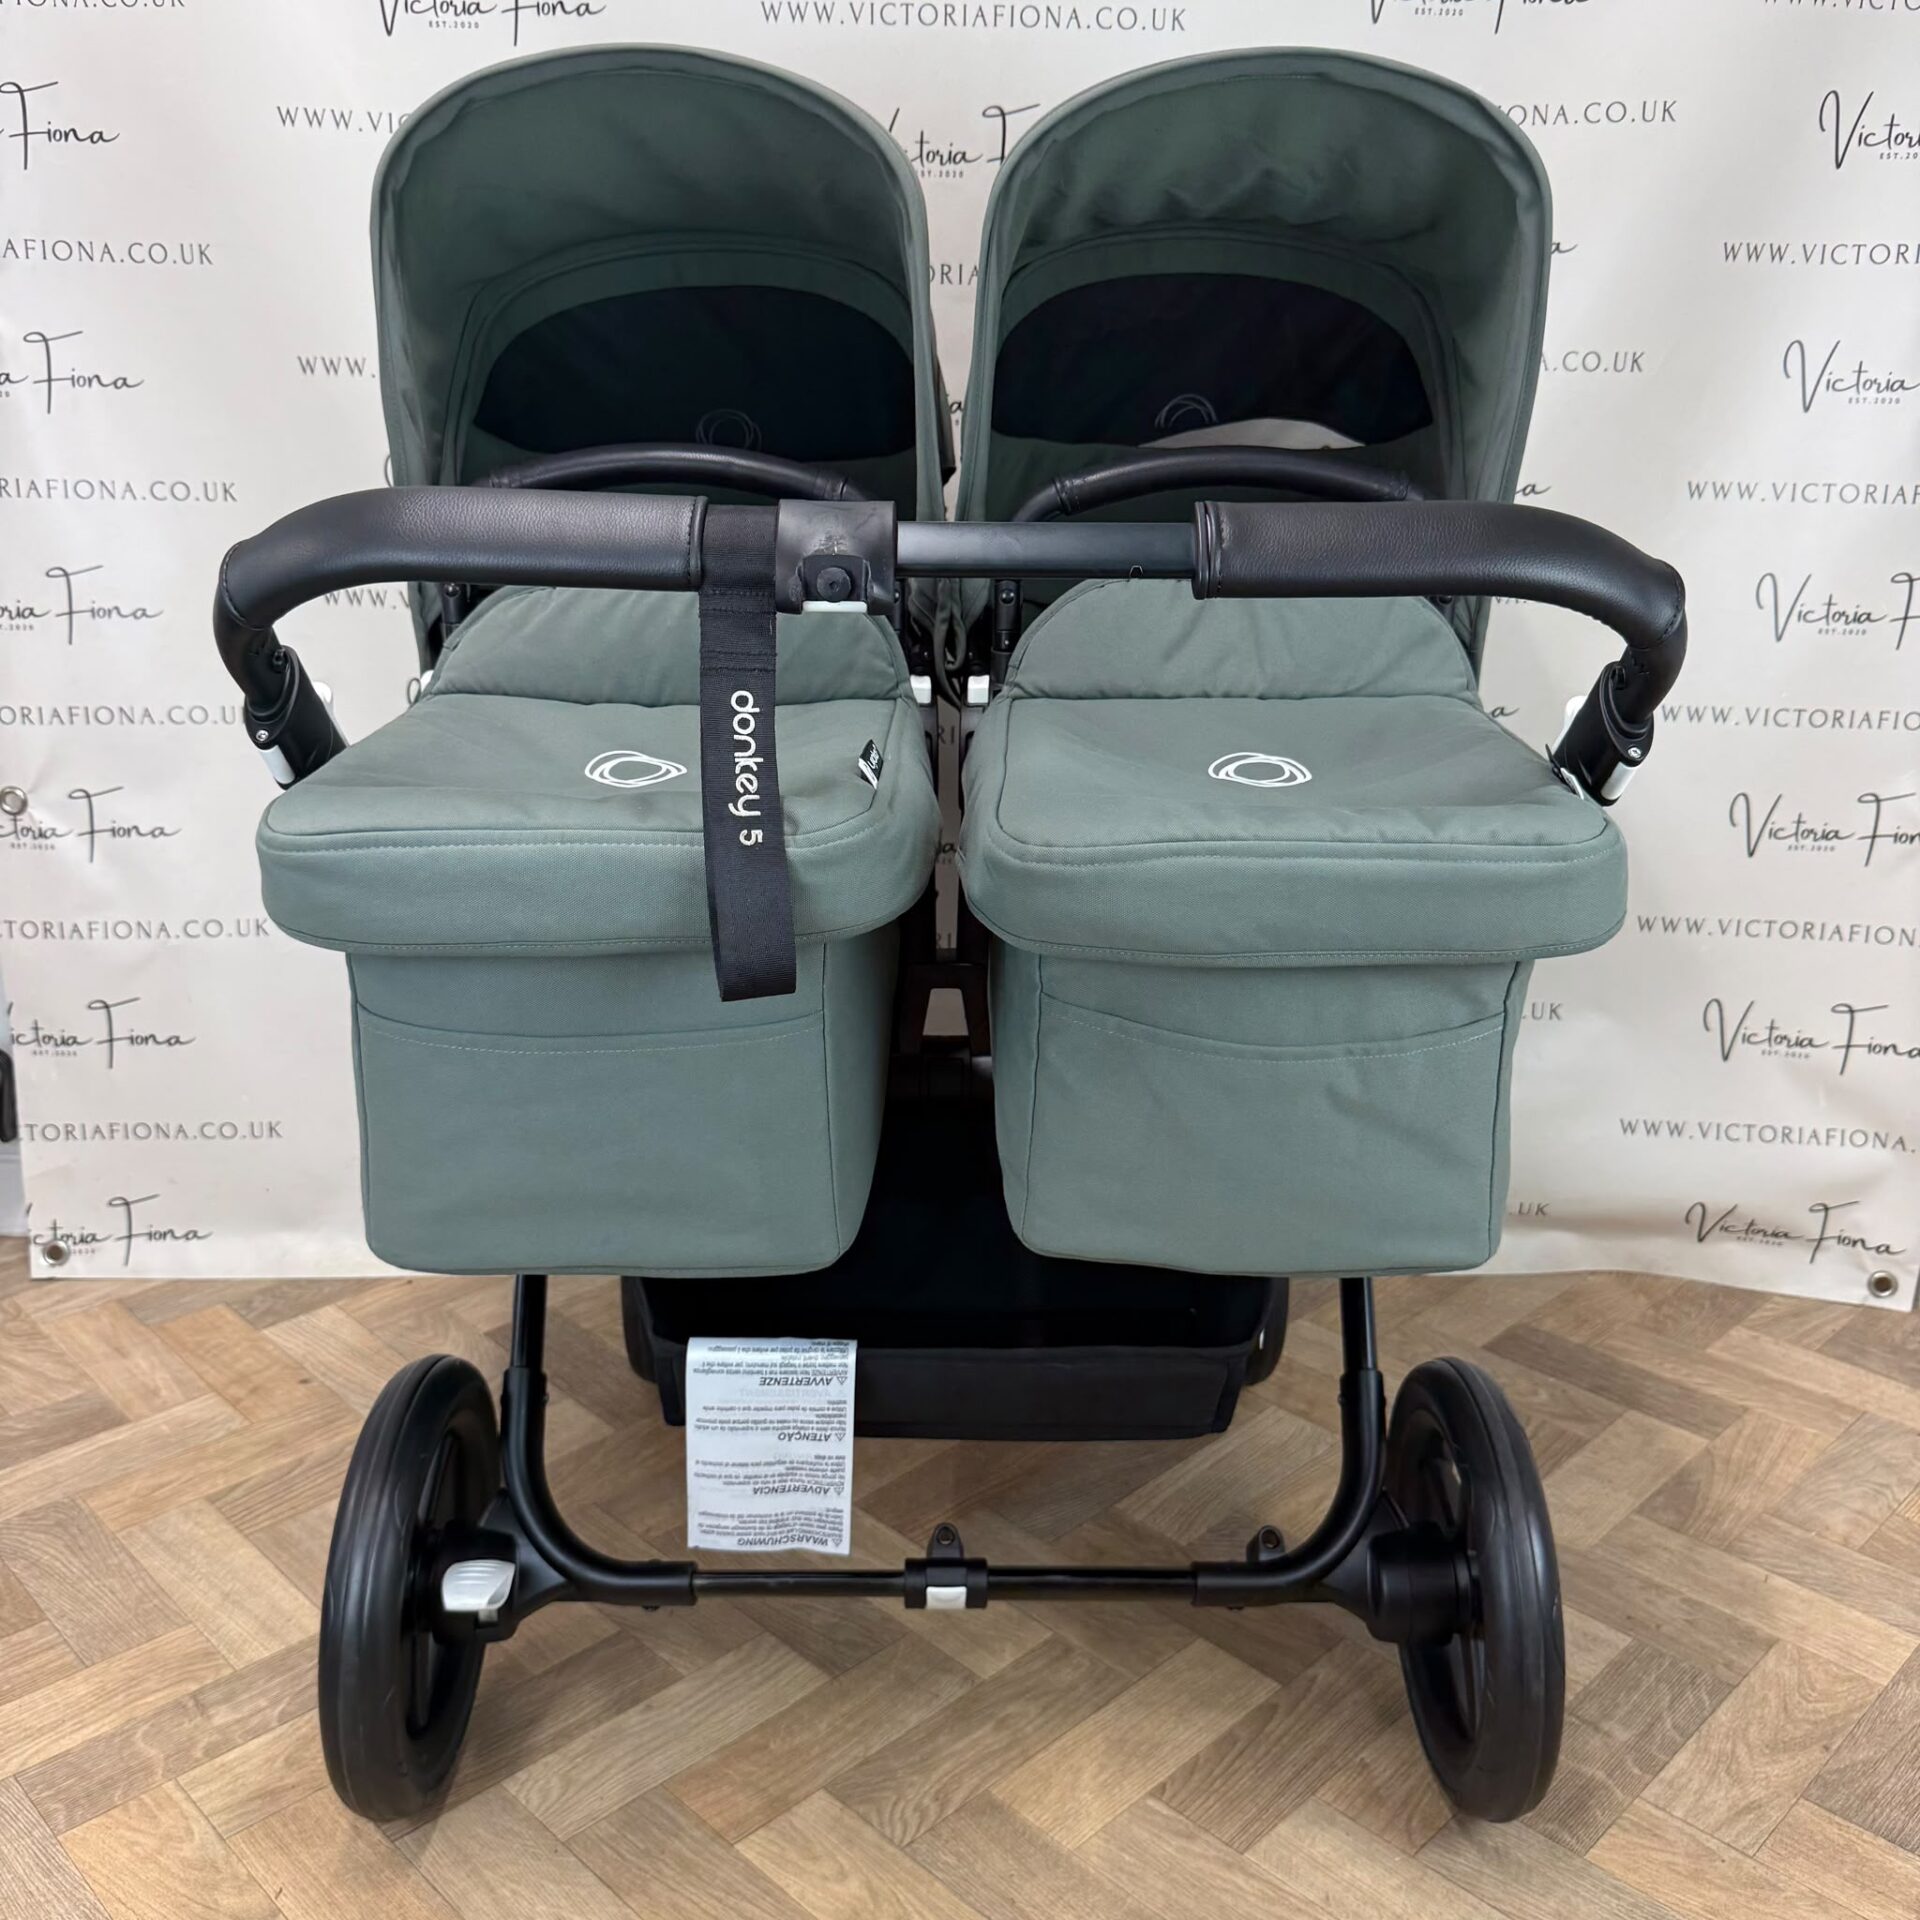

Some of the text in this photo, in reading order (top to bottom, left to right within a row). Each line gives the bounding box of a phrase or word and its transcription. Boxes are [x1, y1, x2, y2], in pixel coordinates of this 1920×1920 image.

[761, 1, 1187, 32] WWW.VICTORIAFIONA.CO.UK
[23, 331, 144, 414] Fiona
[1783, 339, 1920, 413] Victoria
[46, 565, 163, 645] Fiona
[1756, 572, 1888, 642] Victoria
[0, 705, 246, 726] ORIAFIONA.CO.U
[728, 690, 764, 847] donkey 5
[68, 786, 182, 863] Fiona
[1729, 792, 1856, 858] Victoria
[0, 918, 270, 940] TORIAFIONA.CO.UK
[8, 996, 197, 1069] ictoria Fiona
[1703, 998, 1829, 1062] Victoria
[107, 1193, 214, 1267] Fiona
[1685, 1200, 1906, 1264] Victoria Fiona
[759, 1377, 834, 1386] AVVERTENZE
[777, 1431, 832, 1442] ATENÇÃO
[752, 1486, 830, 1496] ADVERTENCIA
[737, 1536, 829, 1547] WAARSCHUWING
